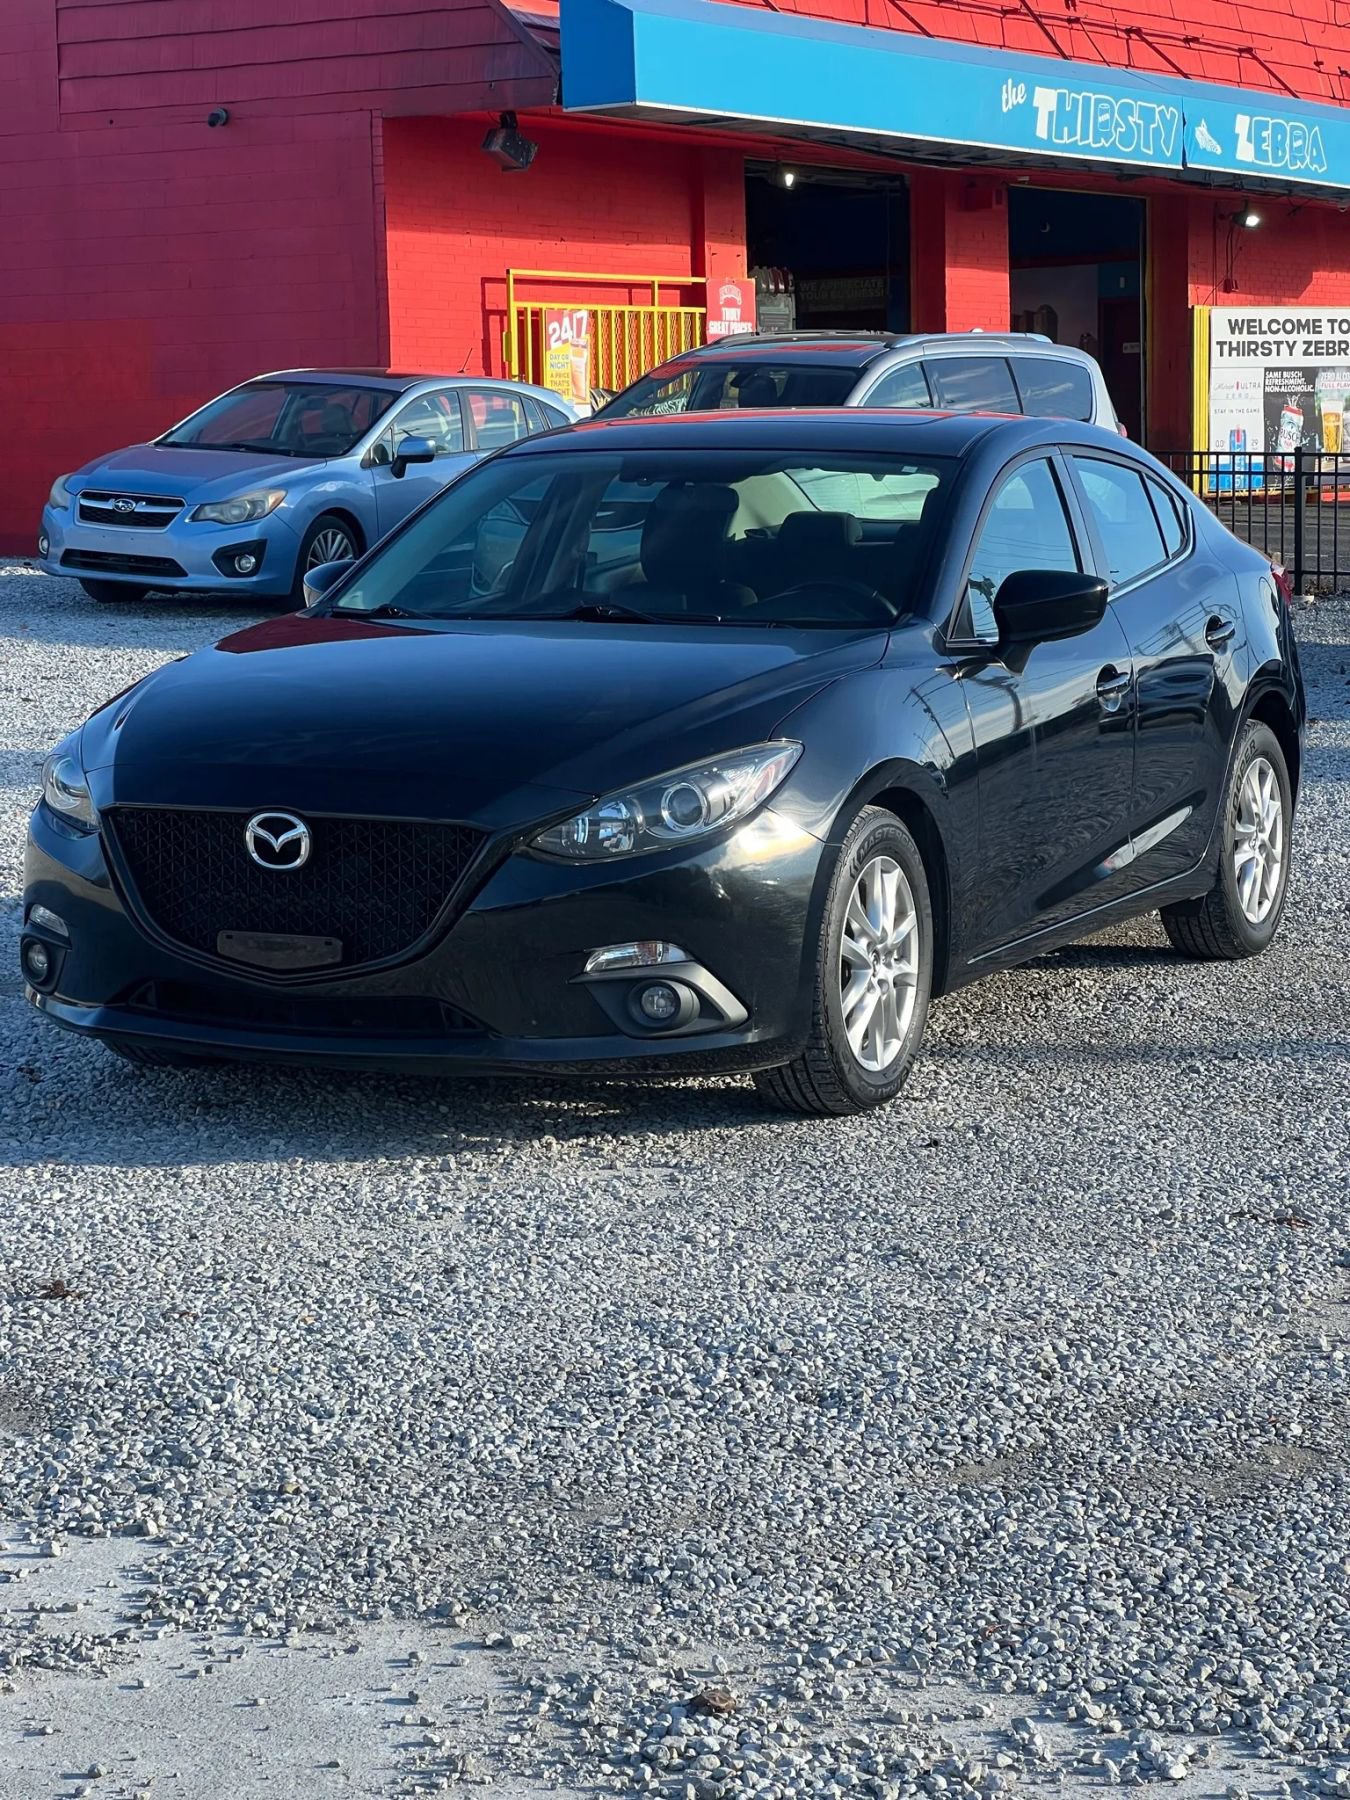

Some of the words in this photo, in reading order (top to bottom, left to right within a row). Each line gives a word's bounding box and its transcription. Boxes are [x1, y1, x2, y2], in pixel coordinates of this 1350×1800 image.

[1002, 78, 1027, 113] the
[1032, 86, 1178, 157] THIRSTY
[1235, 114, 1328, 173] ZEBRA
[1227, 318, 1322, 335] WELCOME
[1326, 318, 1350, 335] TO
[1215, 340, 1297, 357] THIRSTY
[549, 361, 569, 369] NIGHT
[1265, 371, 1282, 379] SAME
[1282, 371, 1303, 379] BUSCH
[1240, 382, 1261, 390] ULTRA
[1265, 378, 1307, 386] REFRESHMENT.
[1264, 385, 1315, 393] NON-ALCOHOLIC.
[1231, 739, 1256, 830] COOPER
